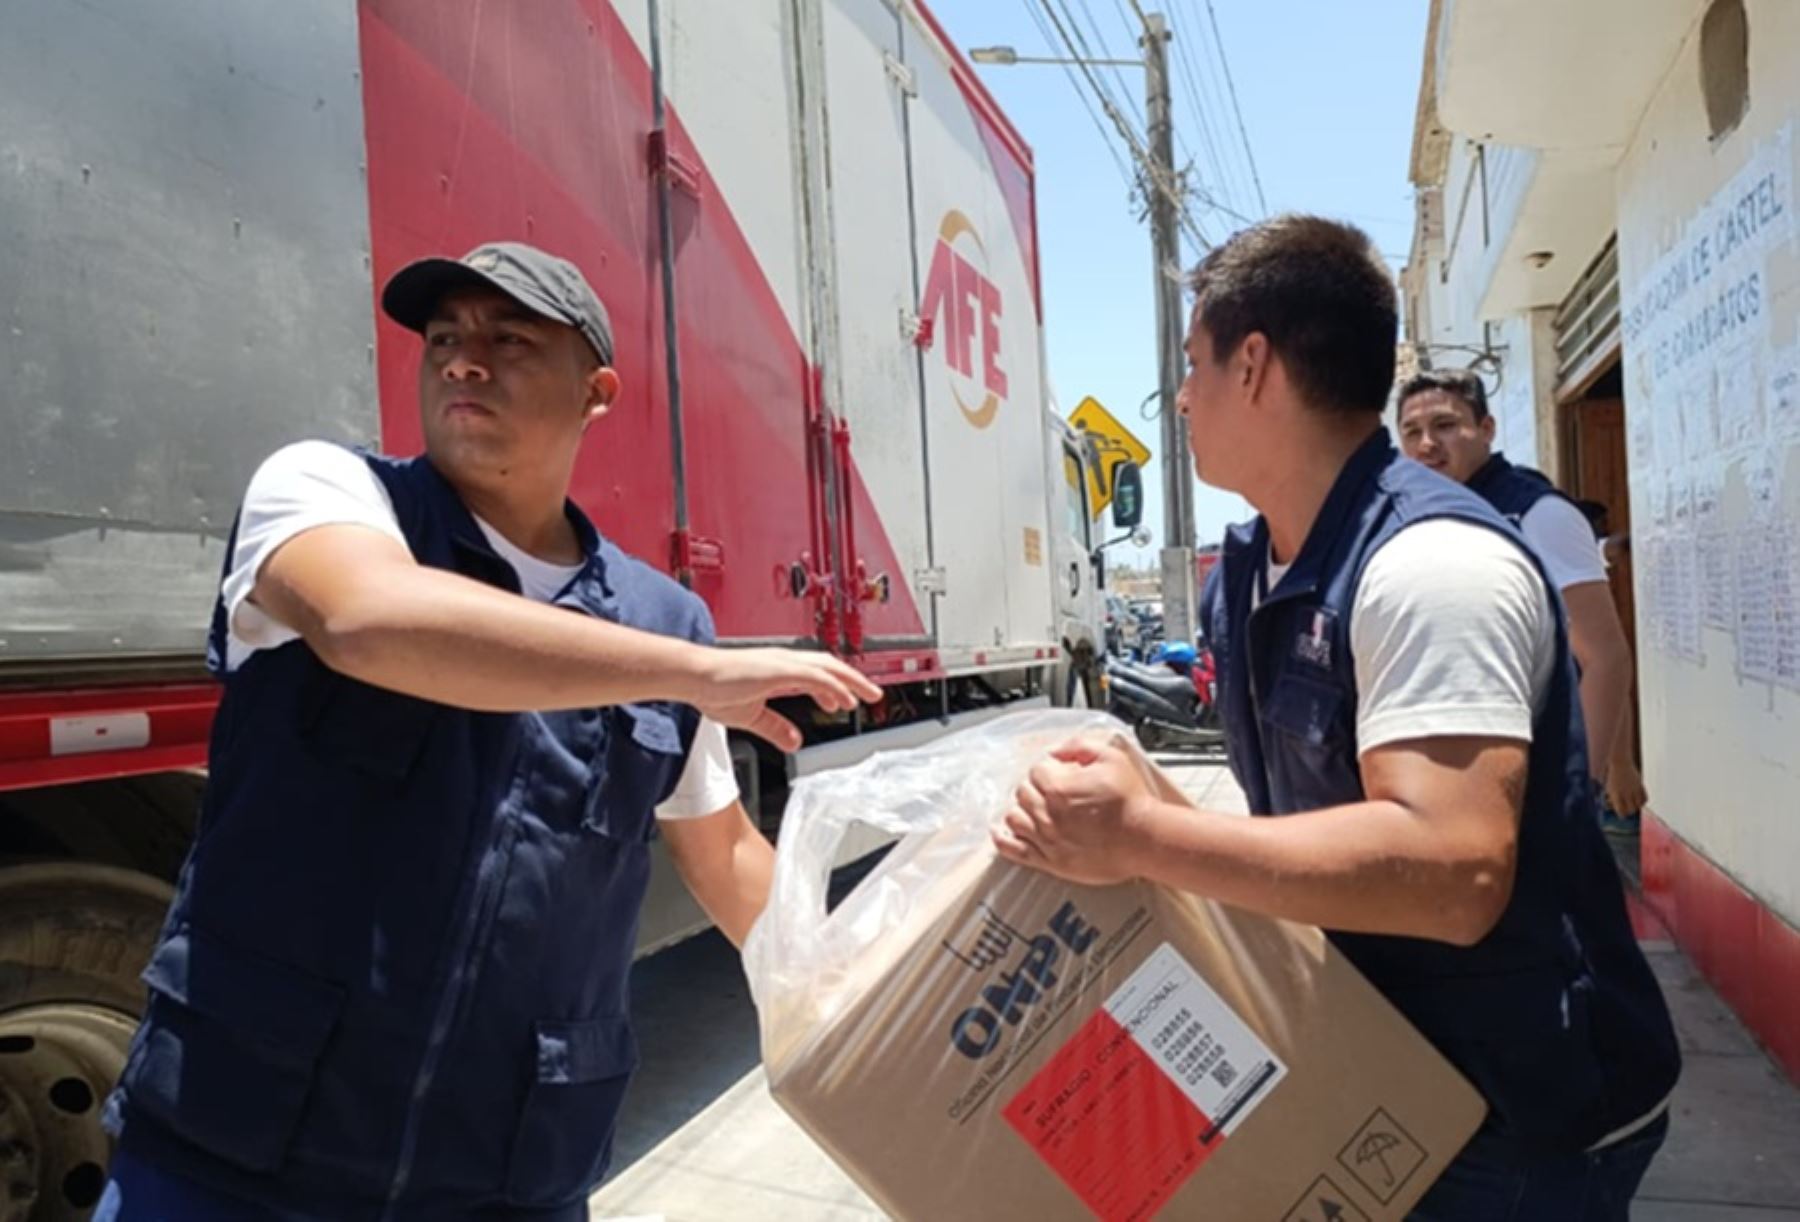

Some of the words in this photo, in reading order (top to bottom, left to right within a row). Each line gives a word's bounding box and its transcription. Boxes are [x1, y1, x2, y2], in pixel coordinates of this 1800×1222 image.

[1717, 173, 1783, 262] CARTEL
[918, 237, 1008, 401] AFE
[950, 902, 1098, 1059] ONPE
[985, 1027, 1034, 1077] Nacnal
[1035, 1069, 1091, 1128] SUFRAGIO
[1097, 979, 1181, 1065] CONVENCIONAL
